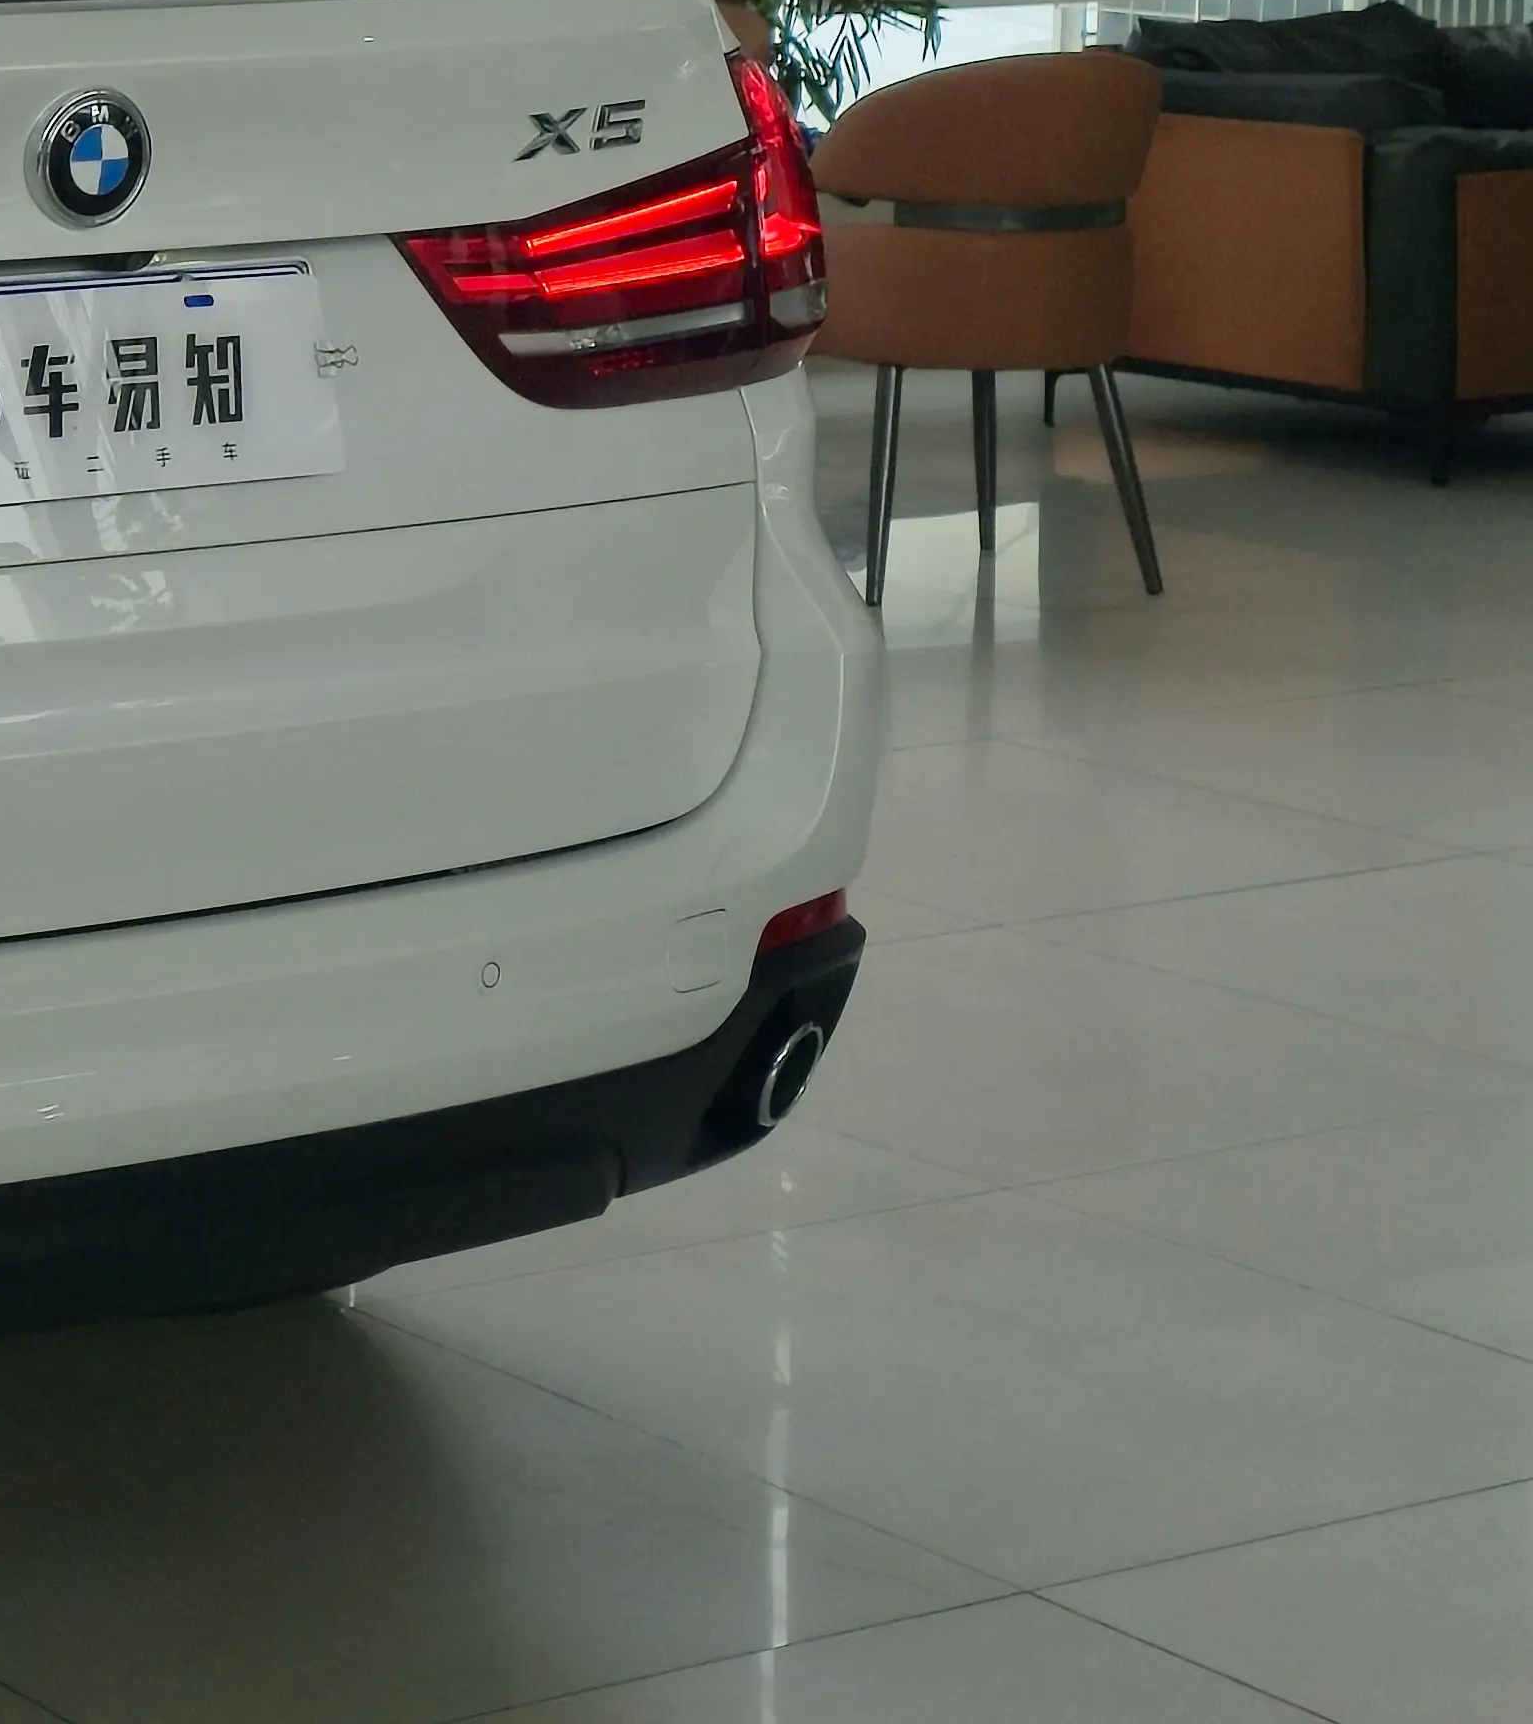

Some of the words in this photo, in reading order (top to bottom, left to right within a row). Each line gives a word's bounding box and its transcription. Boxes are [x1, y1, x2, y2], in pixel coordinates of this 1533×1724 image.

[510, 98, 647, 163] X5
[21, 333, 244, 439] 车易知
